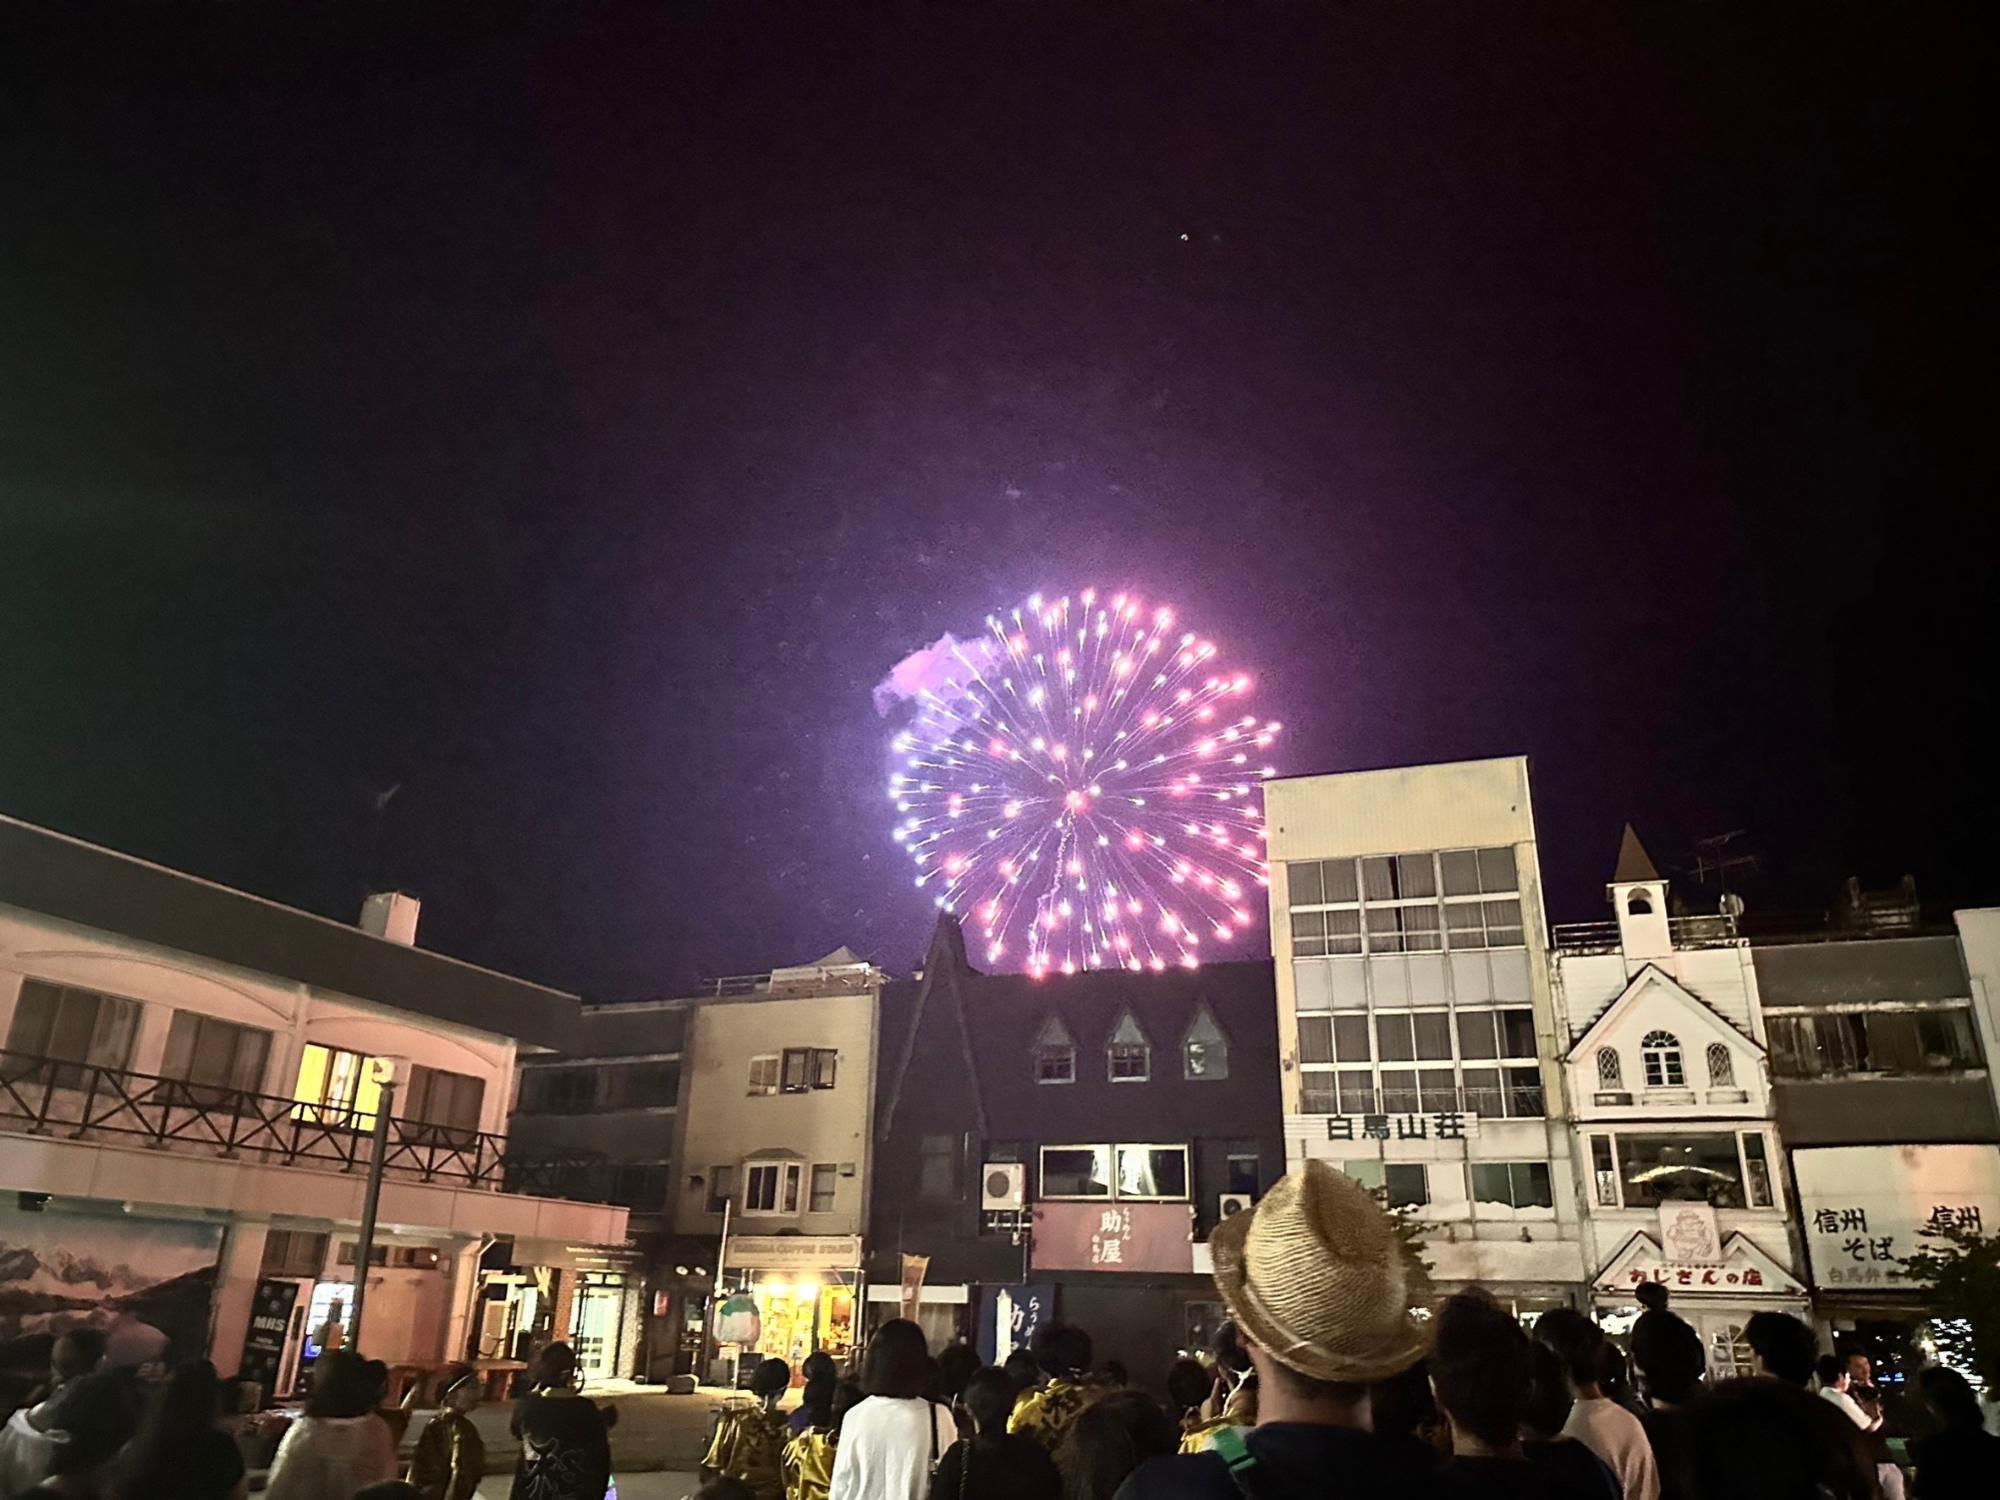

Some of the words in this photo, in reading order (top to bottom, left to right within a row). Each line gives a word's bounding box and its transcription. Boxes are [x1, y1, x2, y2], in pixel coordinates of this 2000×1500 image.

[1327, 1113, 1465, 1140] 白馬山荘
[1813, 1208, 1867, 1233] 信州
[1100, 1208, 1122, 1264] 助屋
[1841, 1236, 1895, 1262] そば
